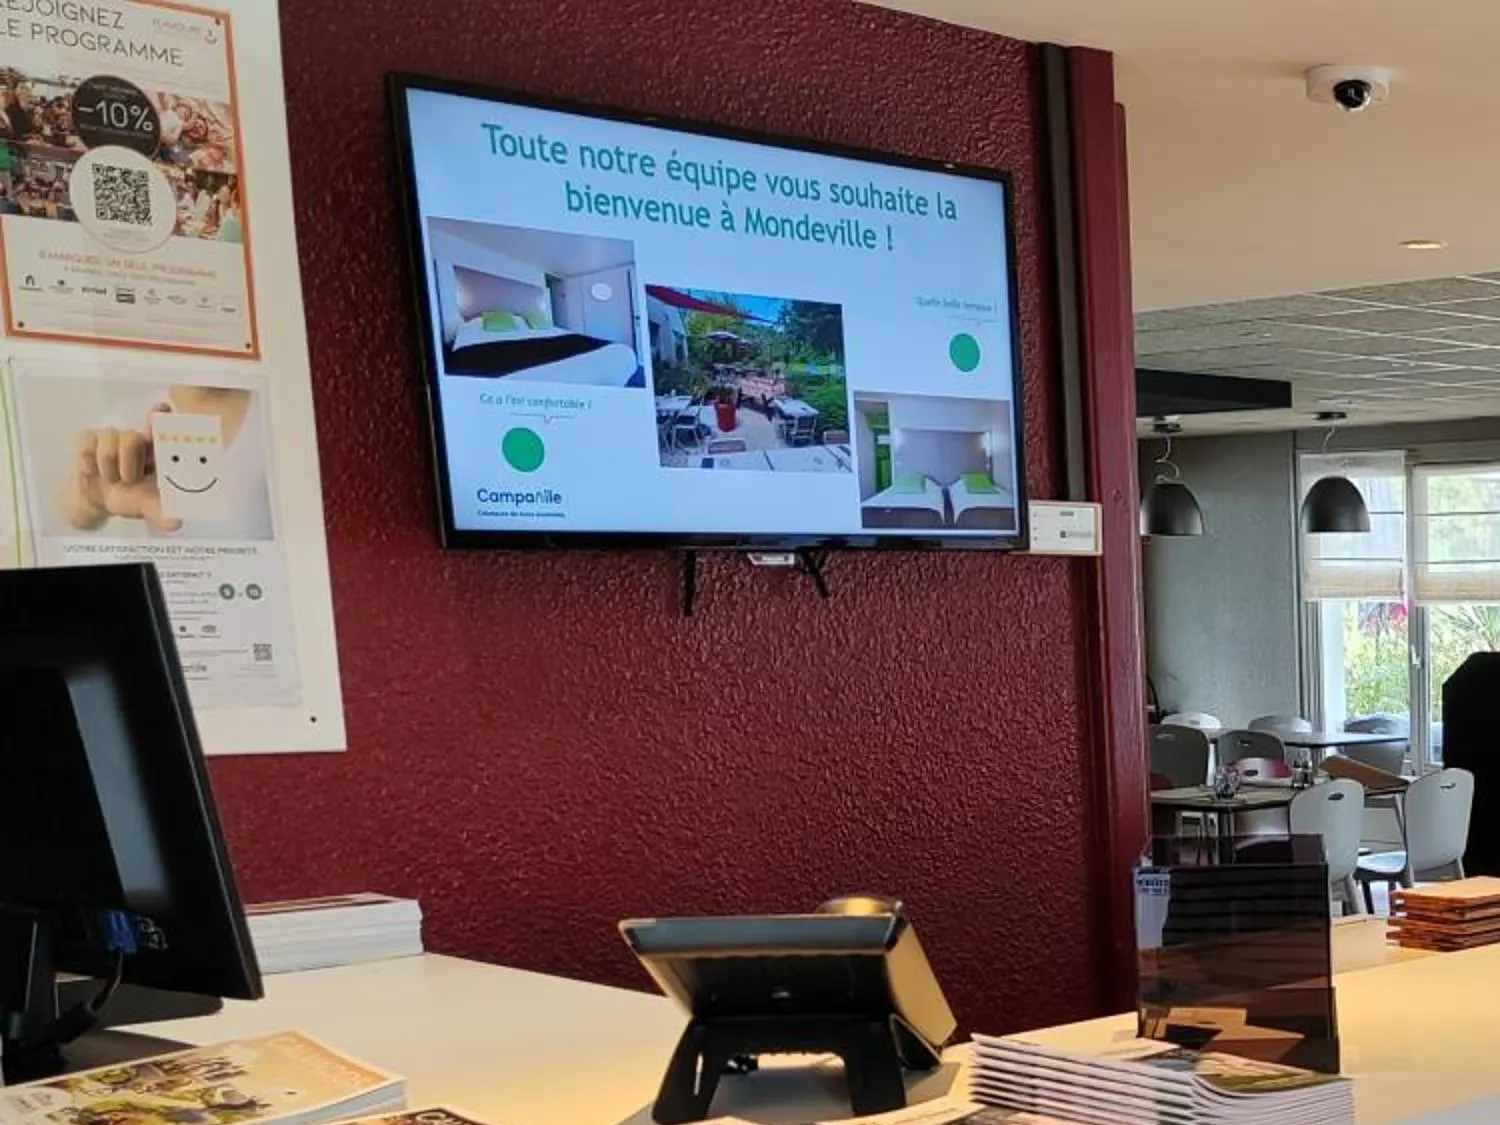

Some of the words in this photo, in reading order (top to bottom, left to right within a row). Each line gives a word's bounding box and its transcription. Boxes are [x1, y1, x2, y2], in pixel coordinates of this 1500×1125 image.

[0, 0, 125, 30] EJOIGNEZ
[31, 23, 184, 67] PROGRAMME
[77, 100, 154, 132] -10%
[481, 122, 568, 165] Toute
[579, 144, 656, 178] notre
[666, 148, 757, 196] équipe
[765, 172, 822, 202] vous
[829, 181, 929, 217] souhaite
[937, 191, 957, 221] la
[565, 180, 711, 229] bienvenue
[721, 201, 735, 232] à
[745, 206, 877, 250] Mondeville
[886, 223, 894, 251] !
